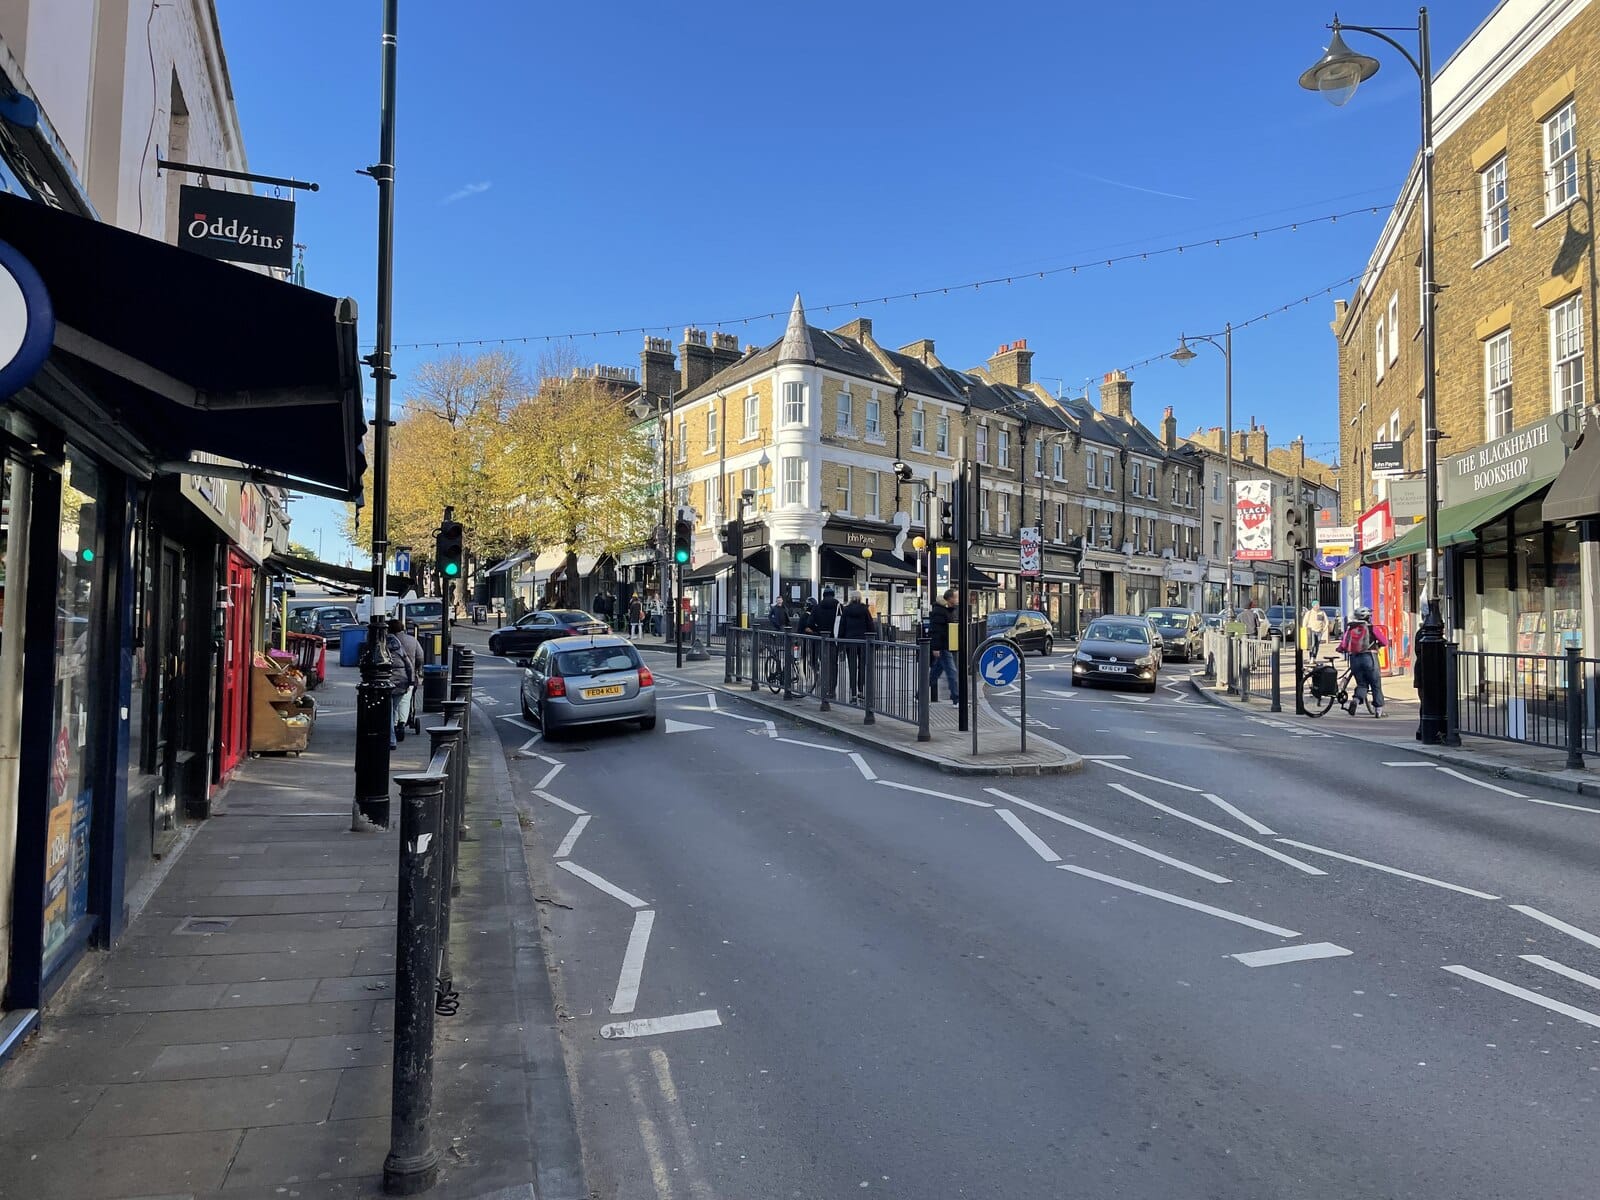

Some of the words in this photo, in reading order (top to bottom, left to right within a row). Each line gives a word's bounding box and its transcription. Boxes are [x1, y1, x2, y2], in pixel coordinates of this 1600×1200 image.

[188, 217, 284, 249] Oddbins
[1456, 454, 1476, 476] THE
[1479, 424, 1549, 468] BLACKHEATH
[1374, 461, 1384, 469] John
[1473, 456, 1529, 491] BOOKSHOP
[1237, 506, 1267, 516] BLACK
[847, 532, 860, 544] John
[860, 534, 876, 547] Payne
[605, 686, 619, 694] KLU
